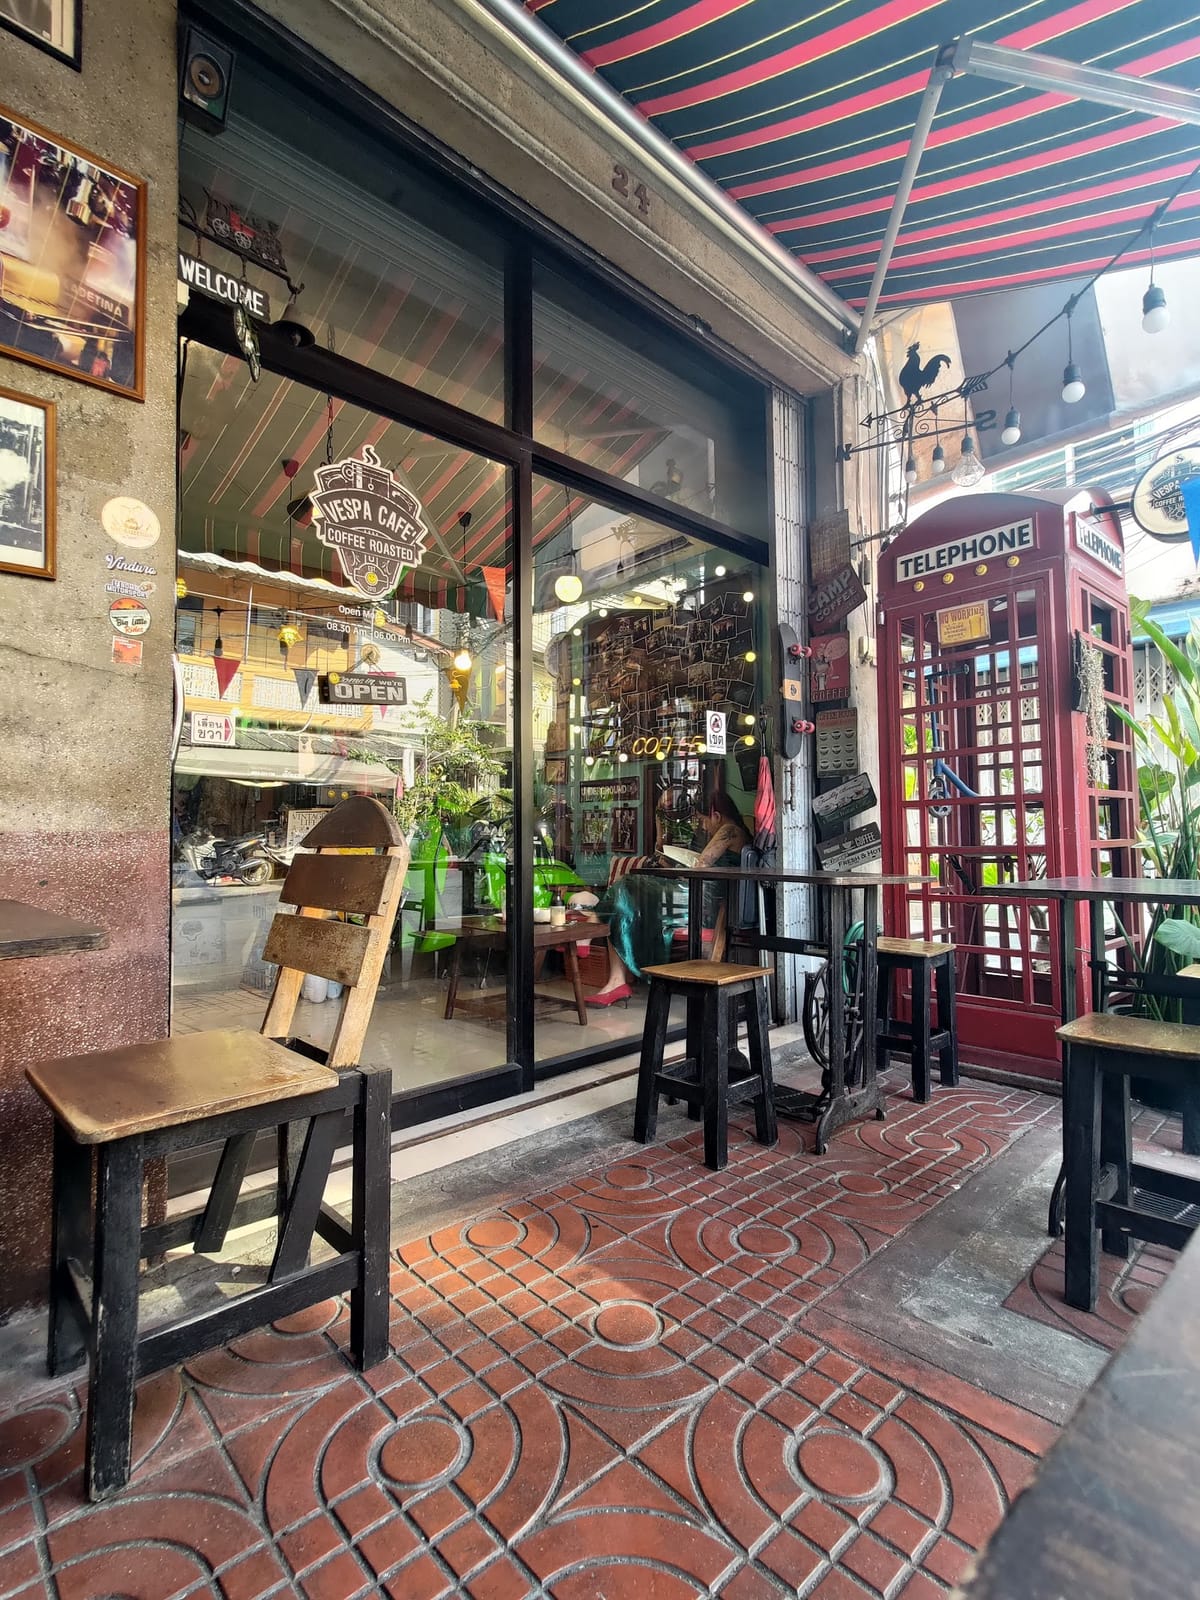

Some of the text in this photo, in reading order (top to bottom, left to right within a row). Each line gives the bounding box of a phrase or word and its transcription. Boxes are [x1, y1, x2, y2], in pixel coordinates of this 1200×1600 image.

[612, 164, 650, 215] 24
[179, 254, 265, 317] WELCOME
[1152, 480, 1181, 499] VESPA
[324, 498, 372, 524] VESPA
[327, 527, 413, 562] COFFEE ROASTED
[900, 523, 1030, 578] TELEPHONE
[807, 569, 851, 614] CAMP
[338, 605, 361, 616] Open
[816, 586, 856, 621] COFFEE
[950, 607, 985, 622] WORKING
[326, 621, 351, 633] 08.30
[353, 627, 367, 636] Am
[373, 631, 396, 641] 06.00
[398, 634, 411, 643] Pm
[334, 684, 404, 701] OPEN
[197, 715, 223, 728] เลื่อน
[197, 729, 223, 740] ขวา
[854, 832, 875, 847] COFFEE
